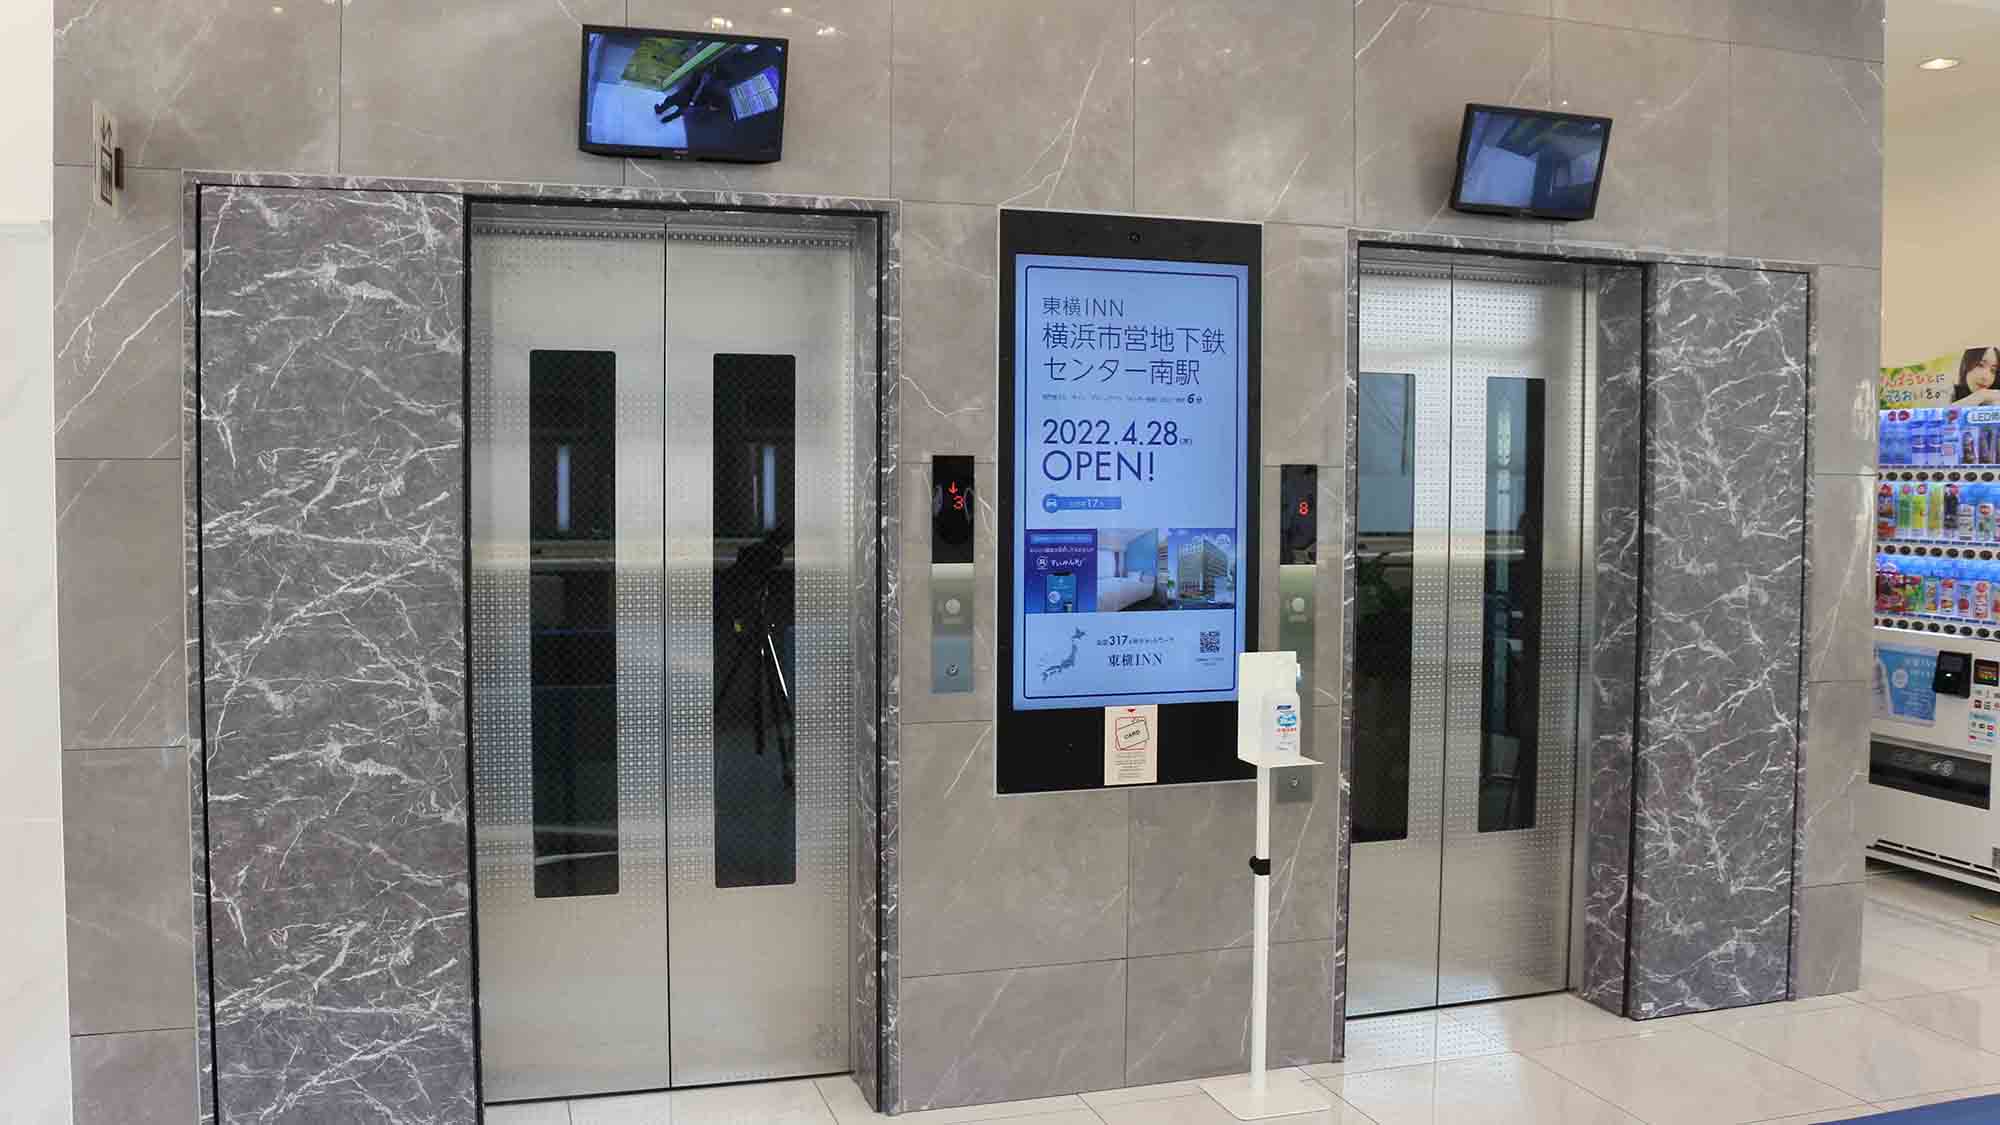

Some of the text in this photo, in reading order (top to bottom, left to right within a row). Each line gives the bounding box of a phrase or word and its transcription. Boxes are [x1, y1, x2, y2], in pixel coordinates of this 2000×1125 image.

[1041, 296, 1125, 317] 東横INN
[1042, 322, 1227, 355] 横浜市営地下鉄
[1043, 356, 1201, 385] センター南駅
[1042, 450, 1155, 482] OPEN!
[953, 495, 964, 510] 3
[1298, 501, 1309, 516] 8
[1108, 653, 1163, 667] 東横INN
